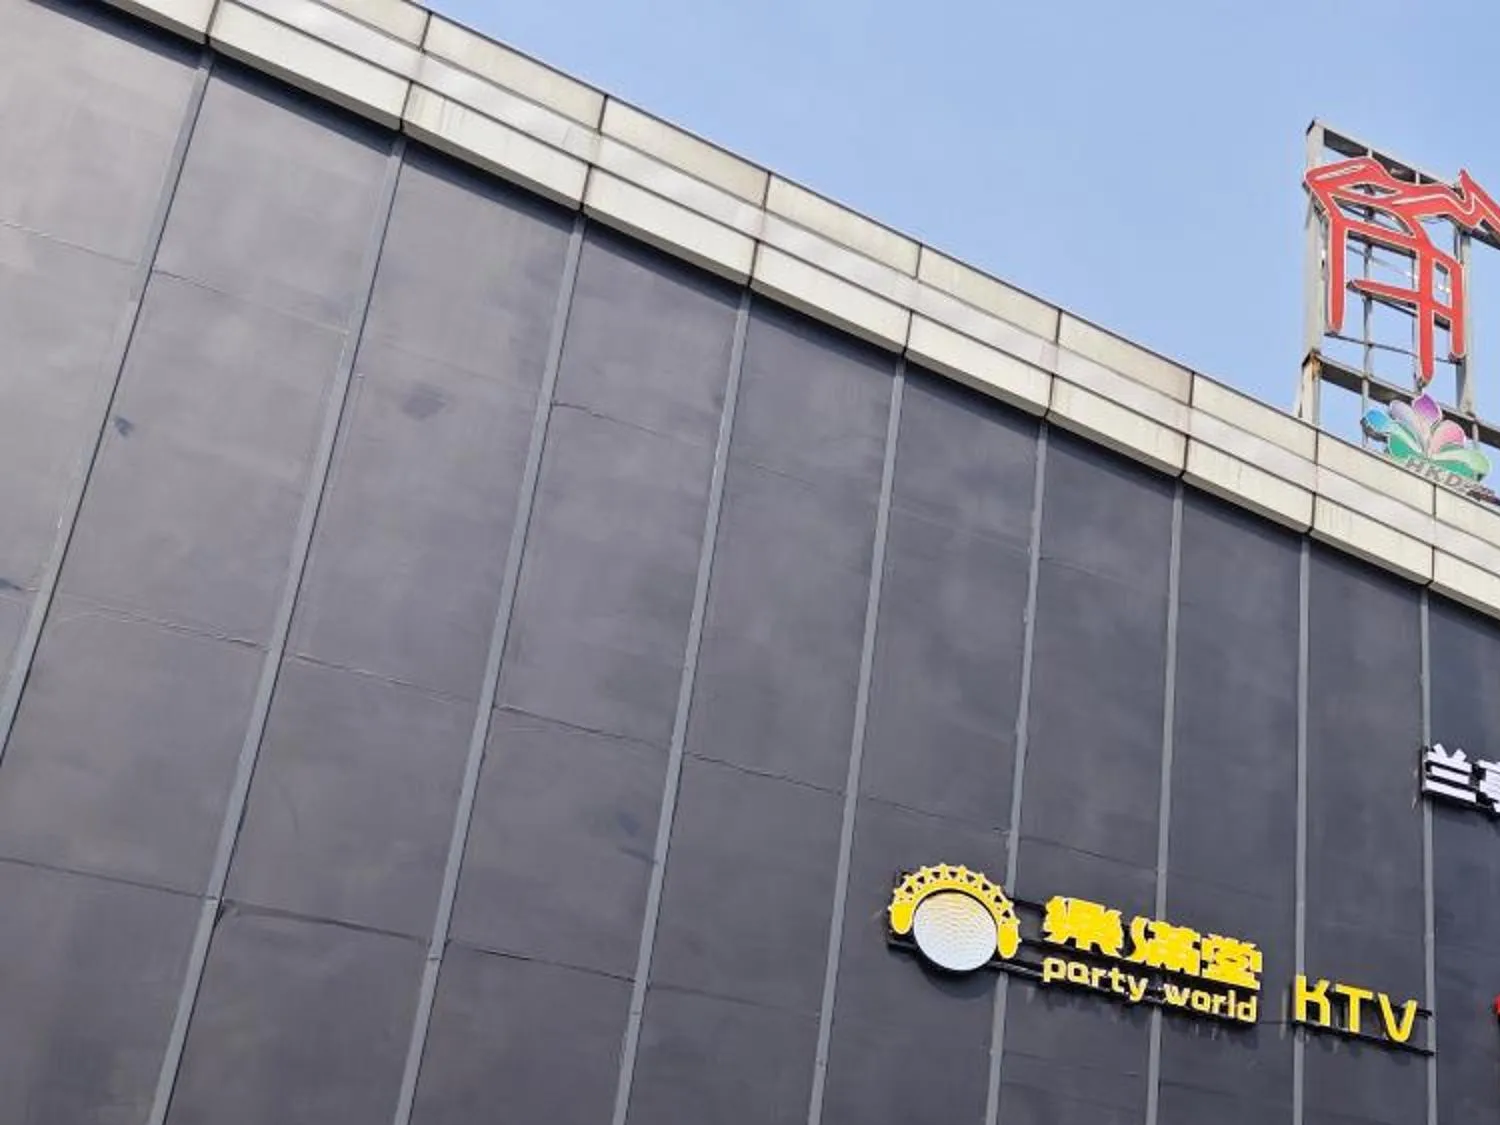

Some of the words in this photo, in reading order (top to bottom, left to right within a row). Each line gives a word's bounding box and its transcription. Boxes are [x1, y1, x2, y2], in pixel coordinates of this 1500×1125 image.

[1043, 956, 1149, 1003] party
[1163, 983, 1258, 1024] world
[1294, 975, 1418, 1043] KTV
